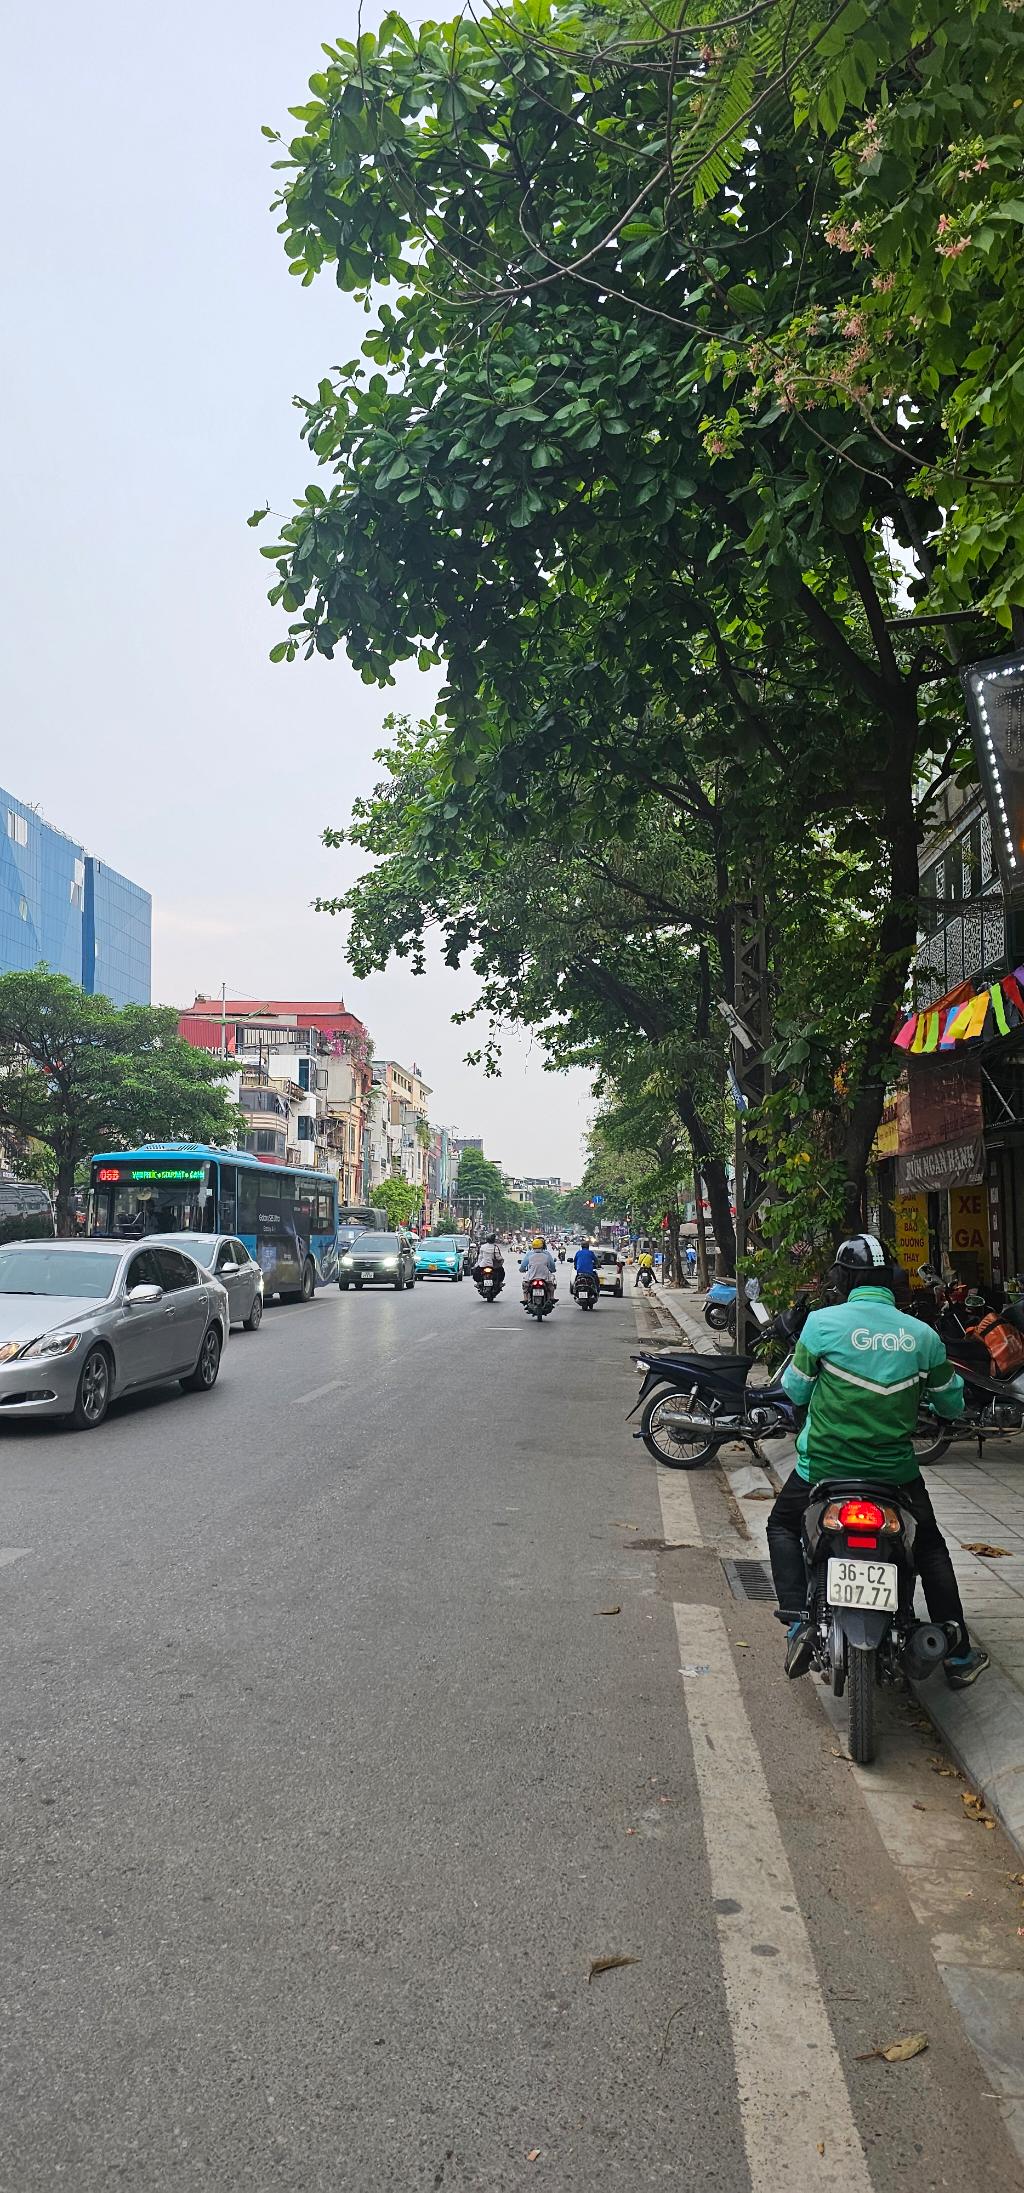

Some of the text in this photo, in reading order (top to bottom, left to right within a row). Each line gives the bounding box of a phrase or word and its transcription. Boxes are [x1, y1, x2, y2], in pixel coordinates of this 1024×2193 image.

[922, 1150, 947, 1177] NGAN
[958, 1195, 982, 1214] XE
[955, 1228, 984, 1248] GA
[903, 1253, 920, 1263] THAY
[851, 1328, 916, 1352] Grab
[838, 1563, 886, 1585] 36-C2
[833, 1584, 892, 1608] 307.77
